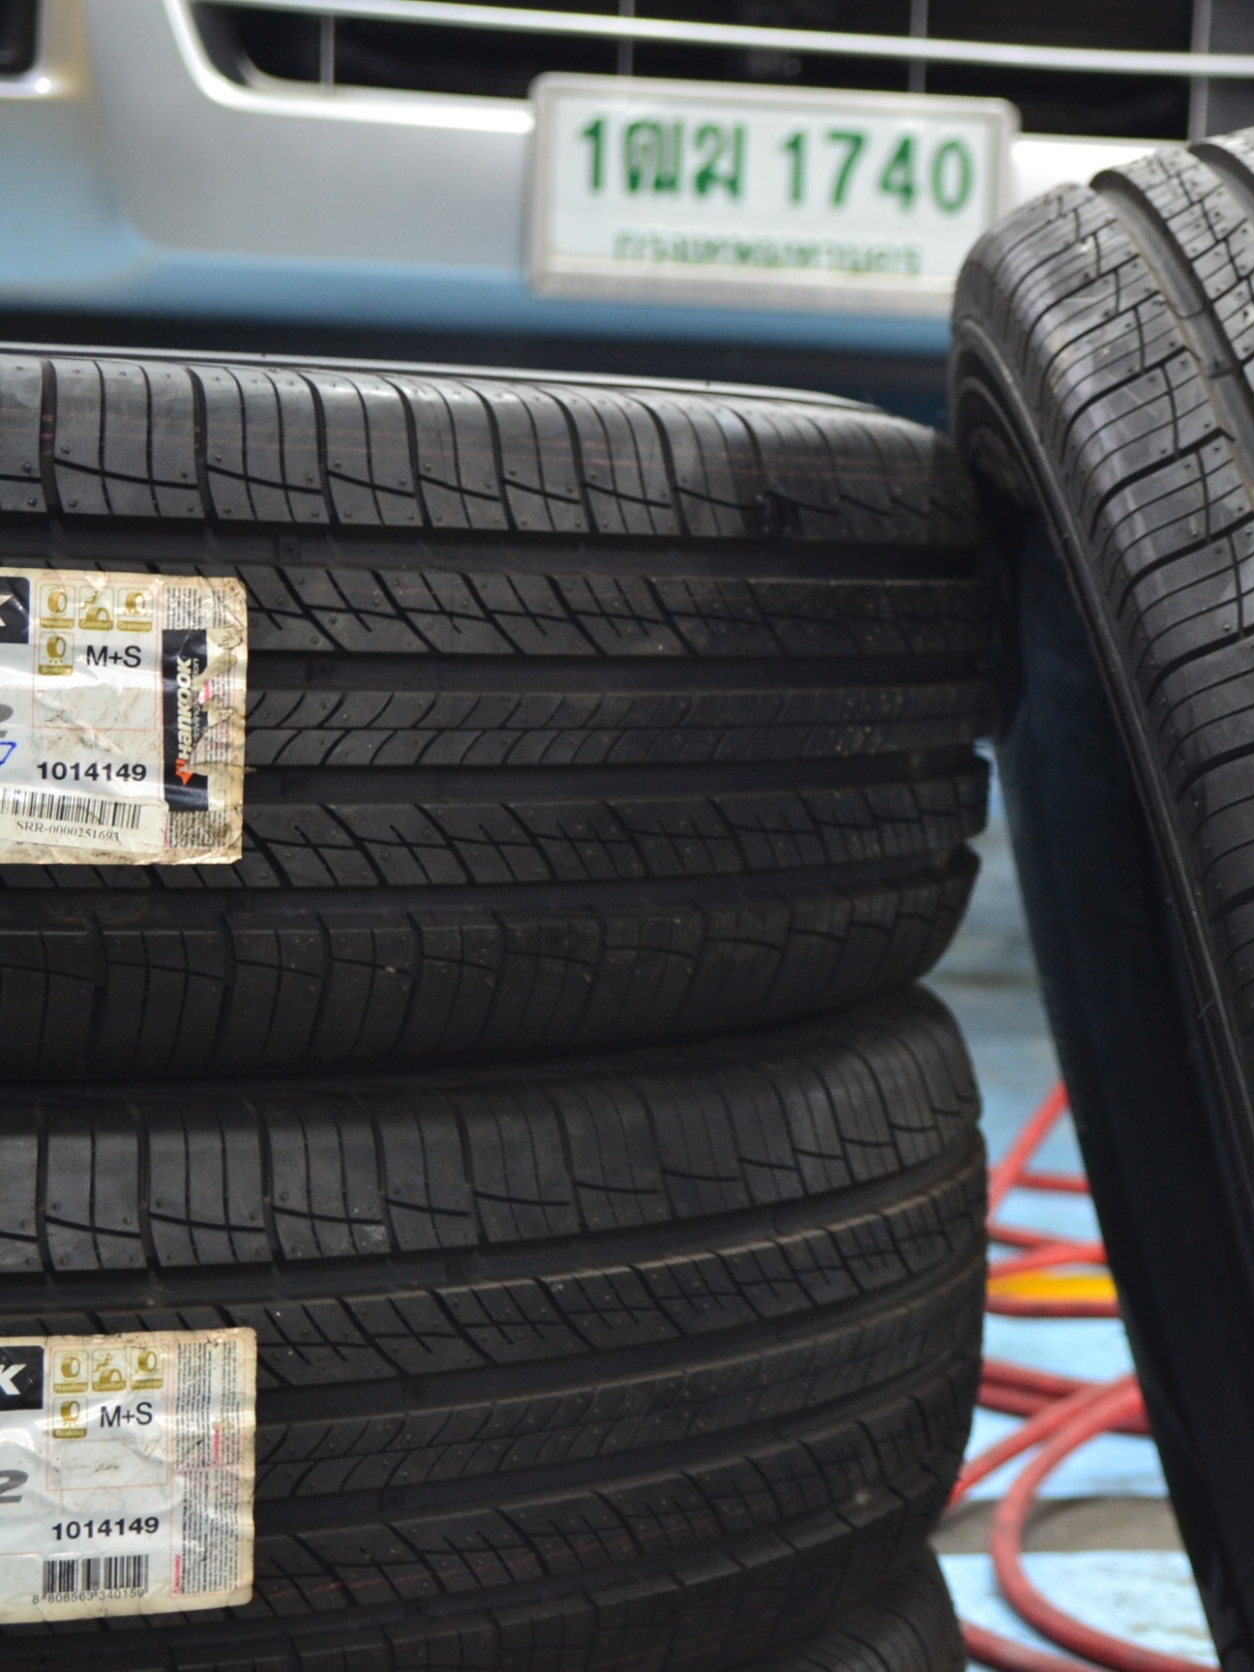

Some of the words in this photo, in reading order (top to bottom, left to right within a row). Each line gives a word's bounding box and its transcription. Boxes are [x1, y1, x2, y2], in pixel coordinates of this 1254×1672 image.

[777, 127, 975, 215] 1740
[86, 644, 142, 668] M+S
[37, 761, 147, 781] 1014149
[16, 820, 120, 842] SRR-0000251693
[100, 1402, 153, 1428] M+S
[52, 1516, 160, 1541] 1014149
